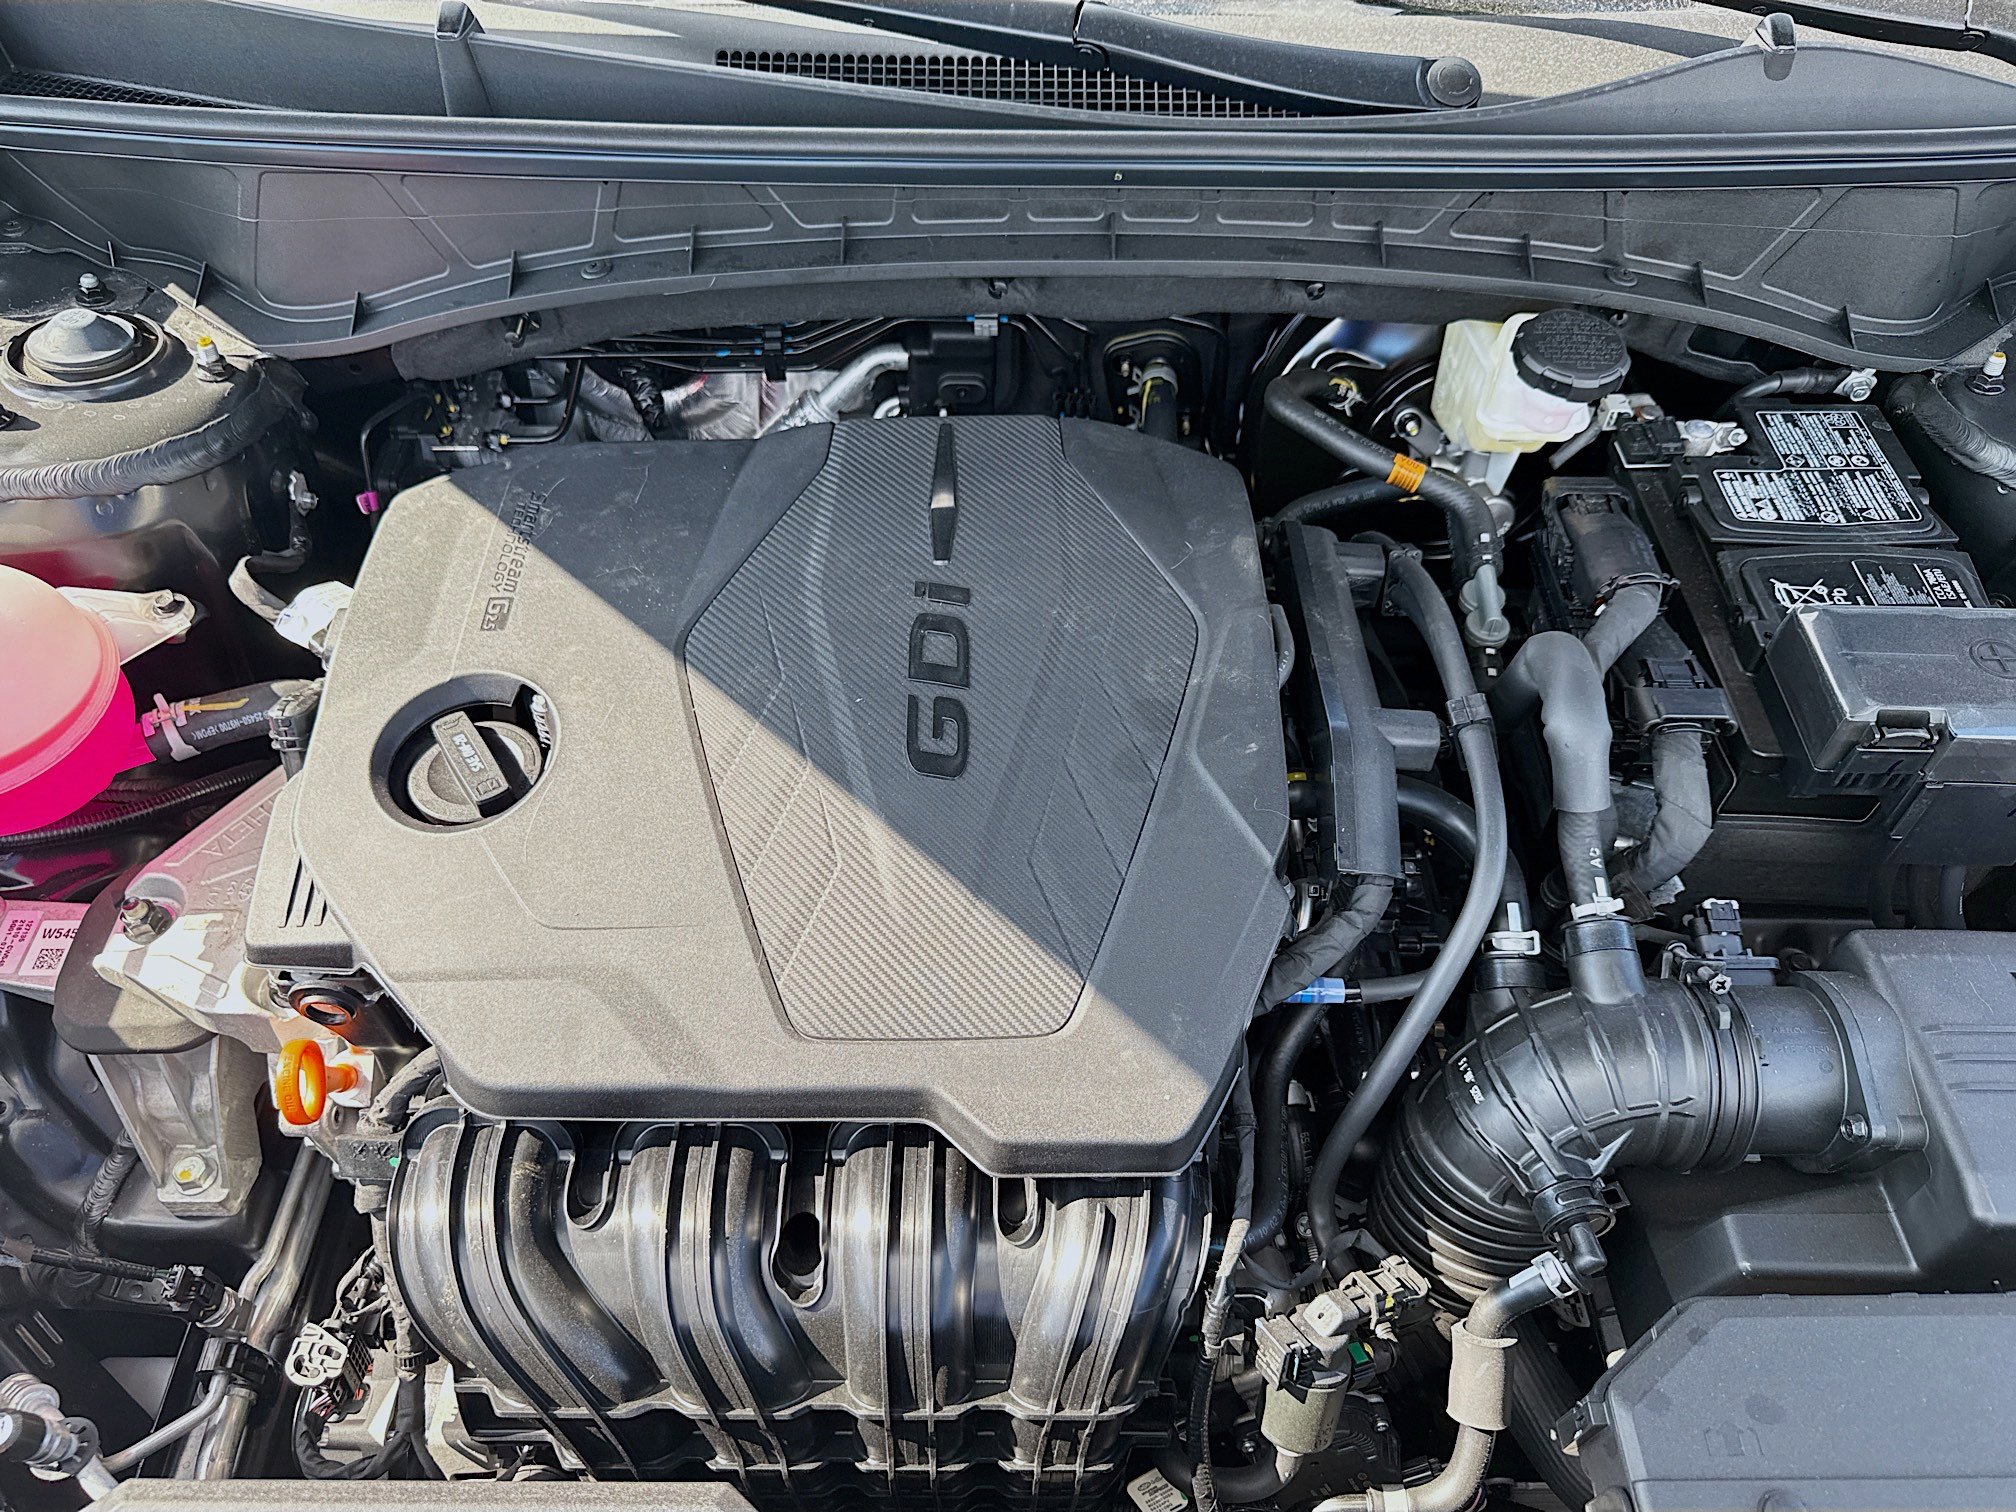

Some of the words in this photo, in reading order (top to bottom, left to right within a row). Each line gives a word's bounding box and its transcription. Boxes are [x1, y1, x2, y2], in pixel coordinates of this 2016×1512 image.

[491, 502, 527, 592] TECHNOLOGY
[503, 490, 548, 593] Smartstream
[1832, 587, 1853, 605] Pb
[1932, 586, 1947, 600] CCA
[906, 580, 971, 780] GDi
[282, 1054, 295, 1092] ENGINE
[284, 1094, 297, 1112] OIL
